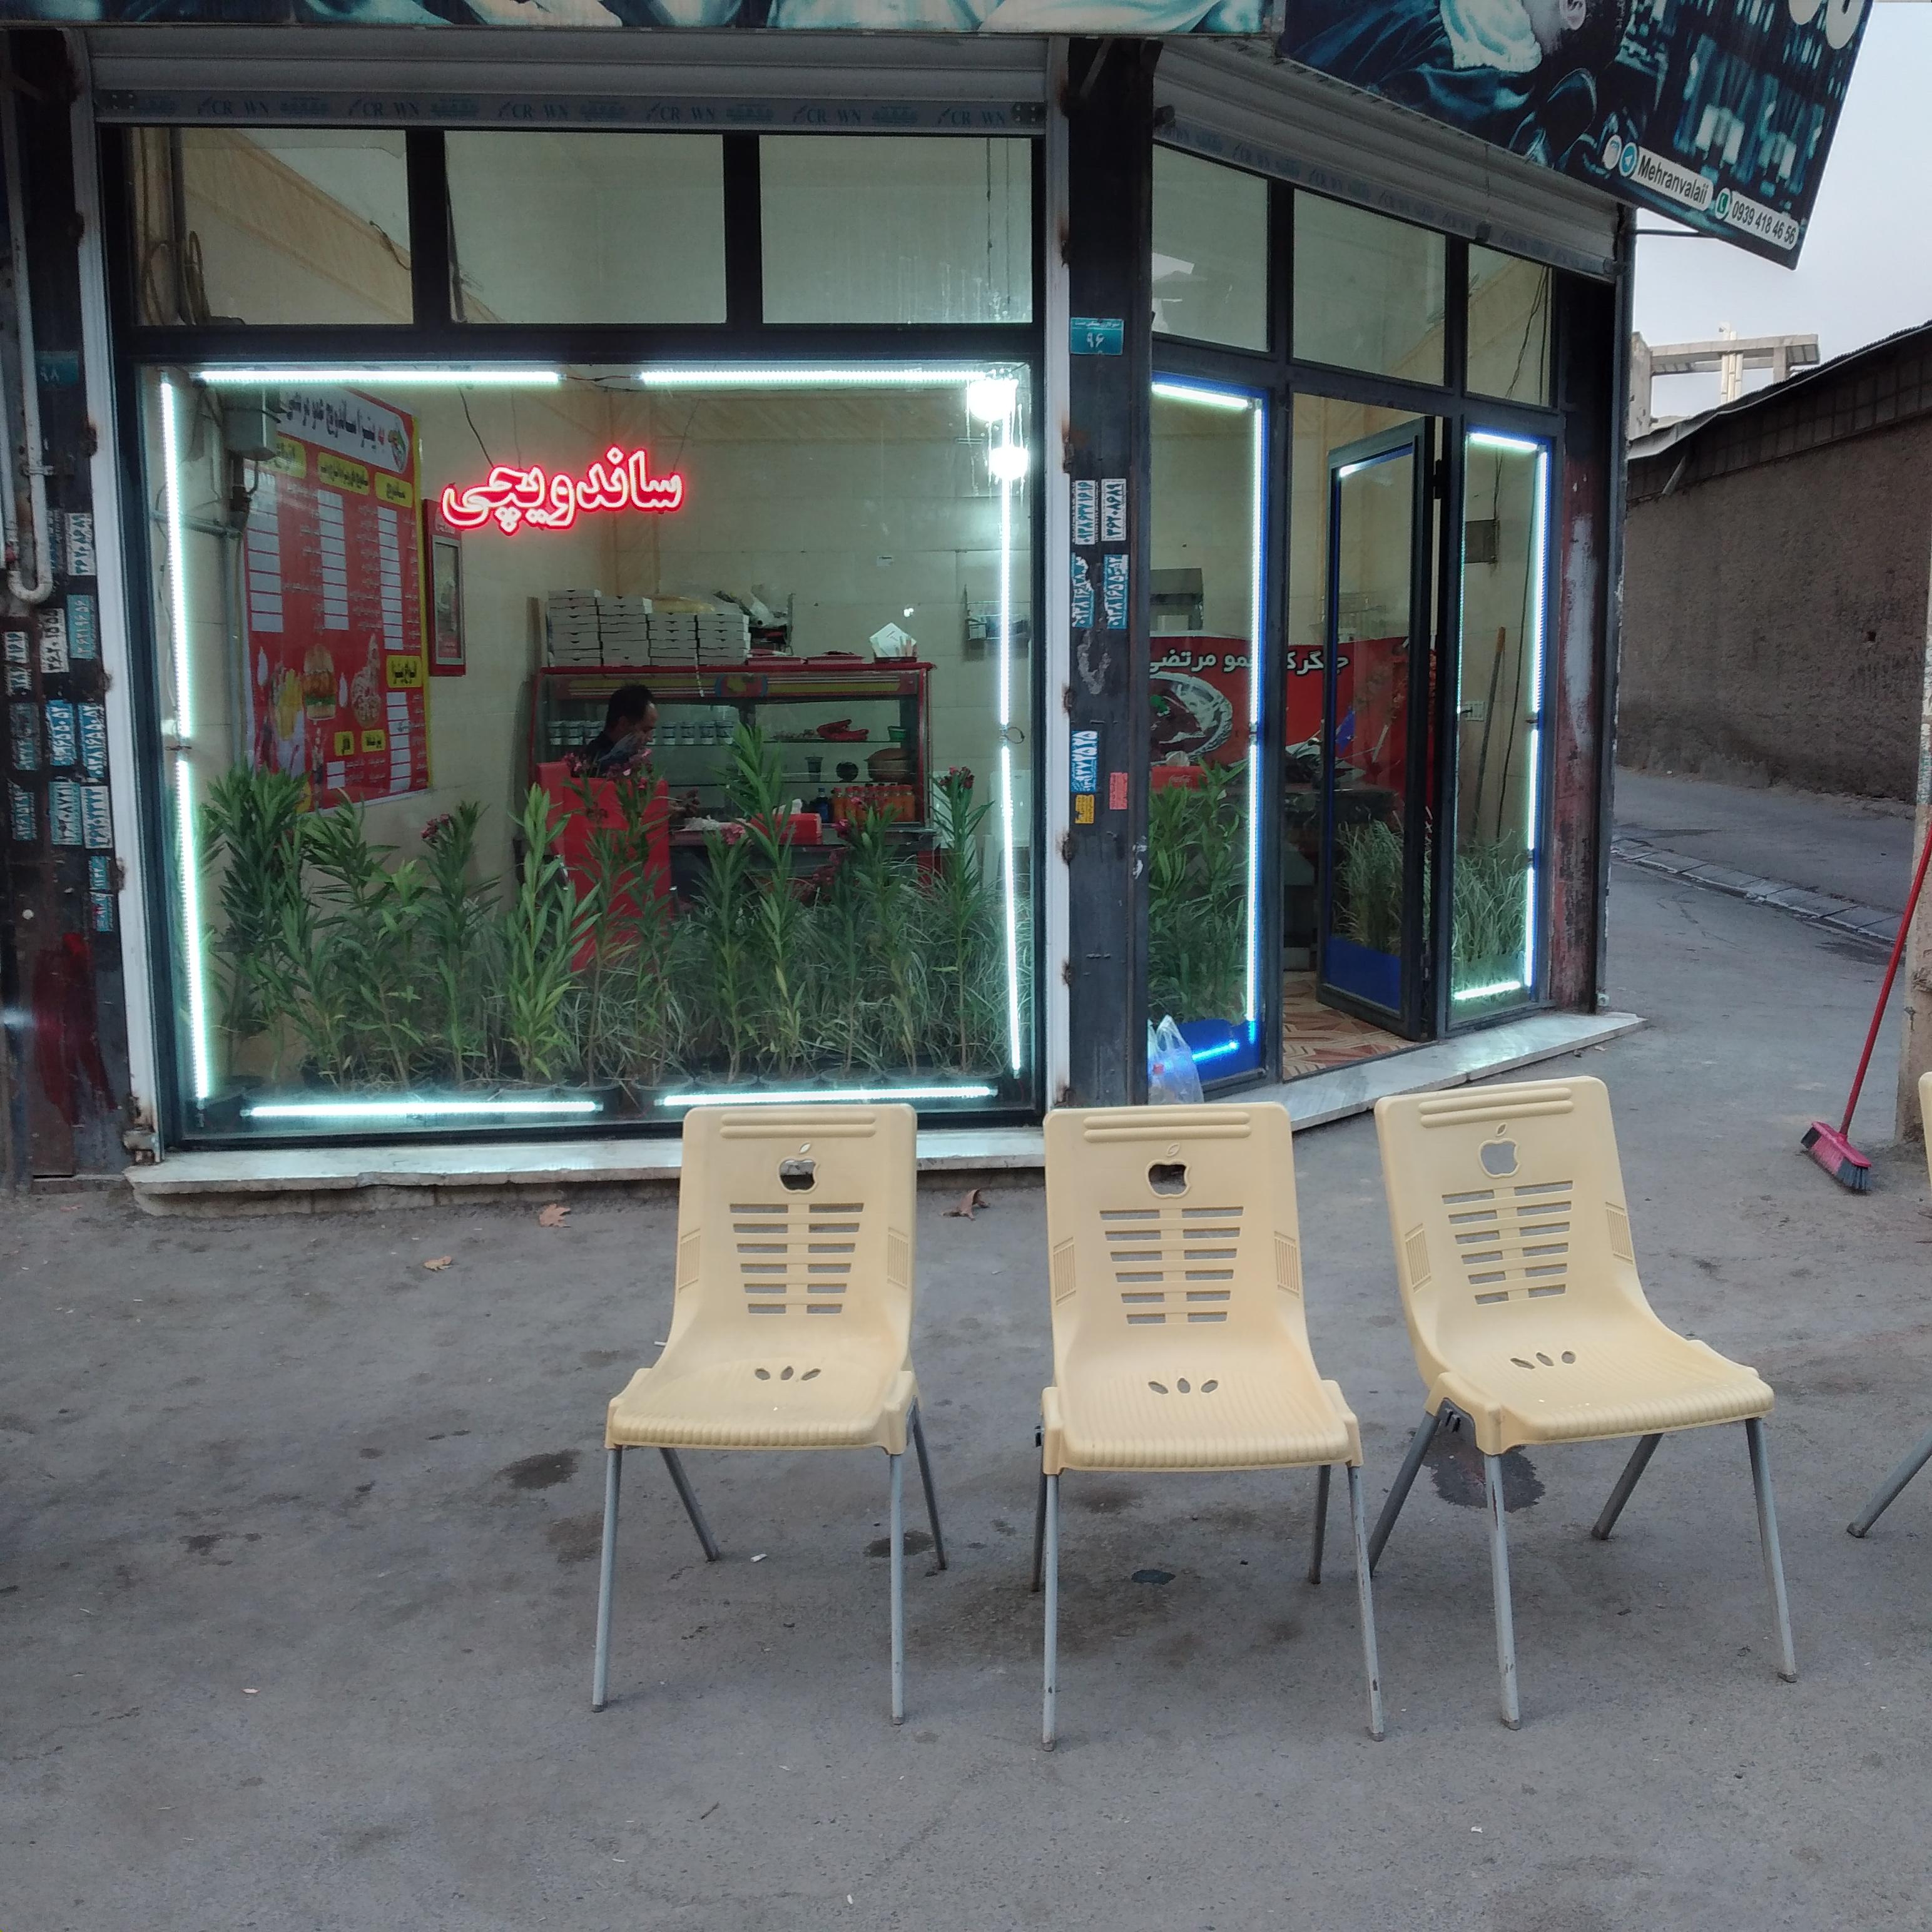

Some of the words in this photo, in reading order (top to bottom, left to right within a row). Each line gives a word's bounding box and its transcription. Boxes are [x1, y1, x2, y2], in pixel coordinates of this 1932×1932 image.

[1638, 155, 1708, 205] Mehranvalaii
[1732, 200, 1753, 225] 0939
[1756, 211, 1771, 235] 418
[1772, 221, 1783, 240] 46
[1784, 225, 1796, 245] 56
[442, 445, 684, 536] ساندویچی
[1224, 654, 1253, 673] مو
